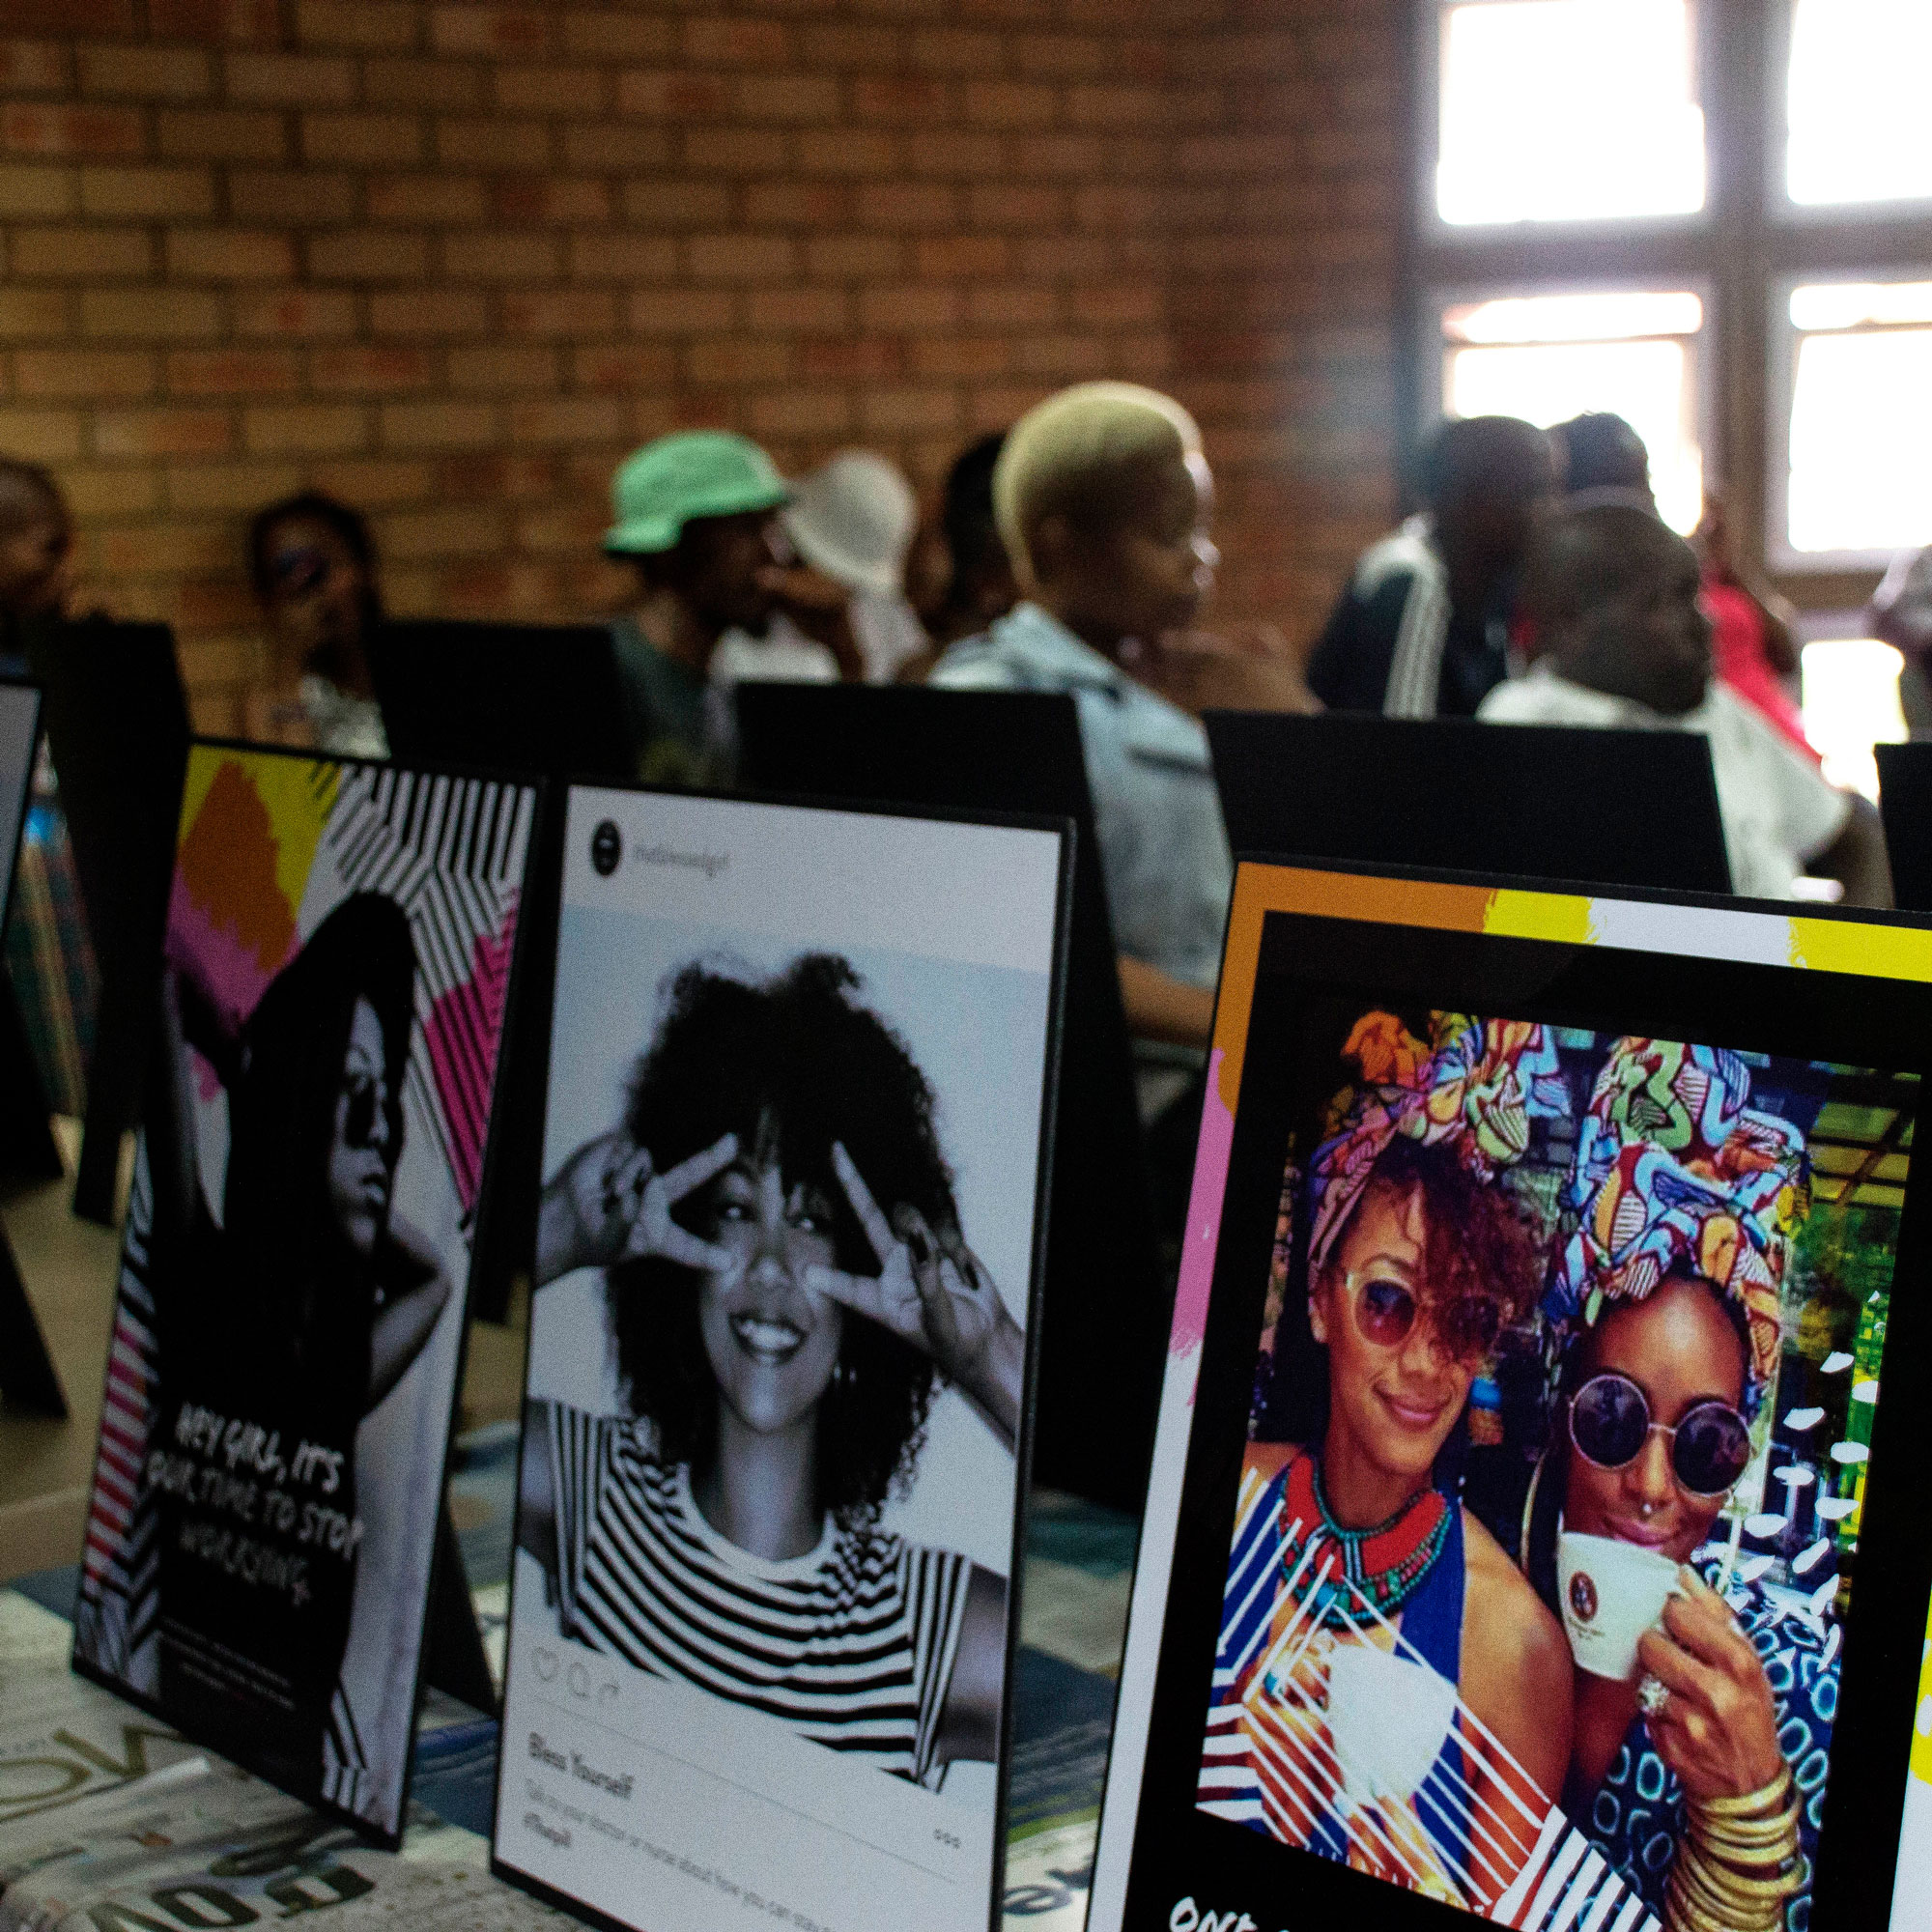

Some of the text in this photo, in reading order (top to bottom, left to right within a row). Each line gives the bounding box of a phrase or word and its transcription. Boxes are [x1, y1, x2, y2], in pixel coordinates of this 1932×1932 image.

[175, 1401, 226, 1459] HEY
[262, 1489, 297, 1532] TO
[297, 1500, 365, 1561] STOP
